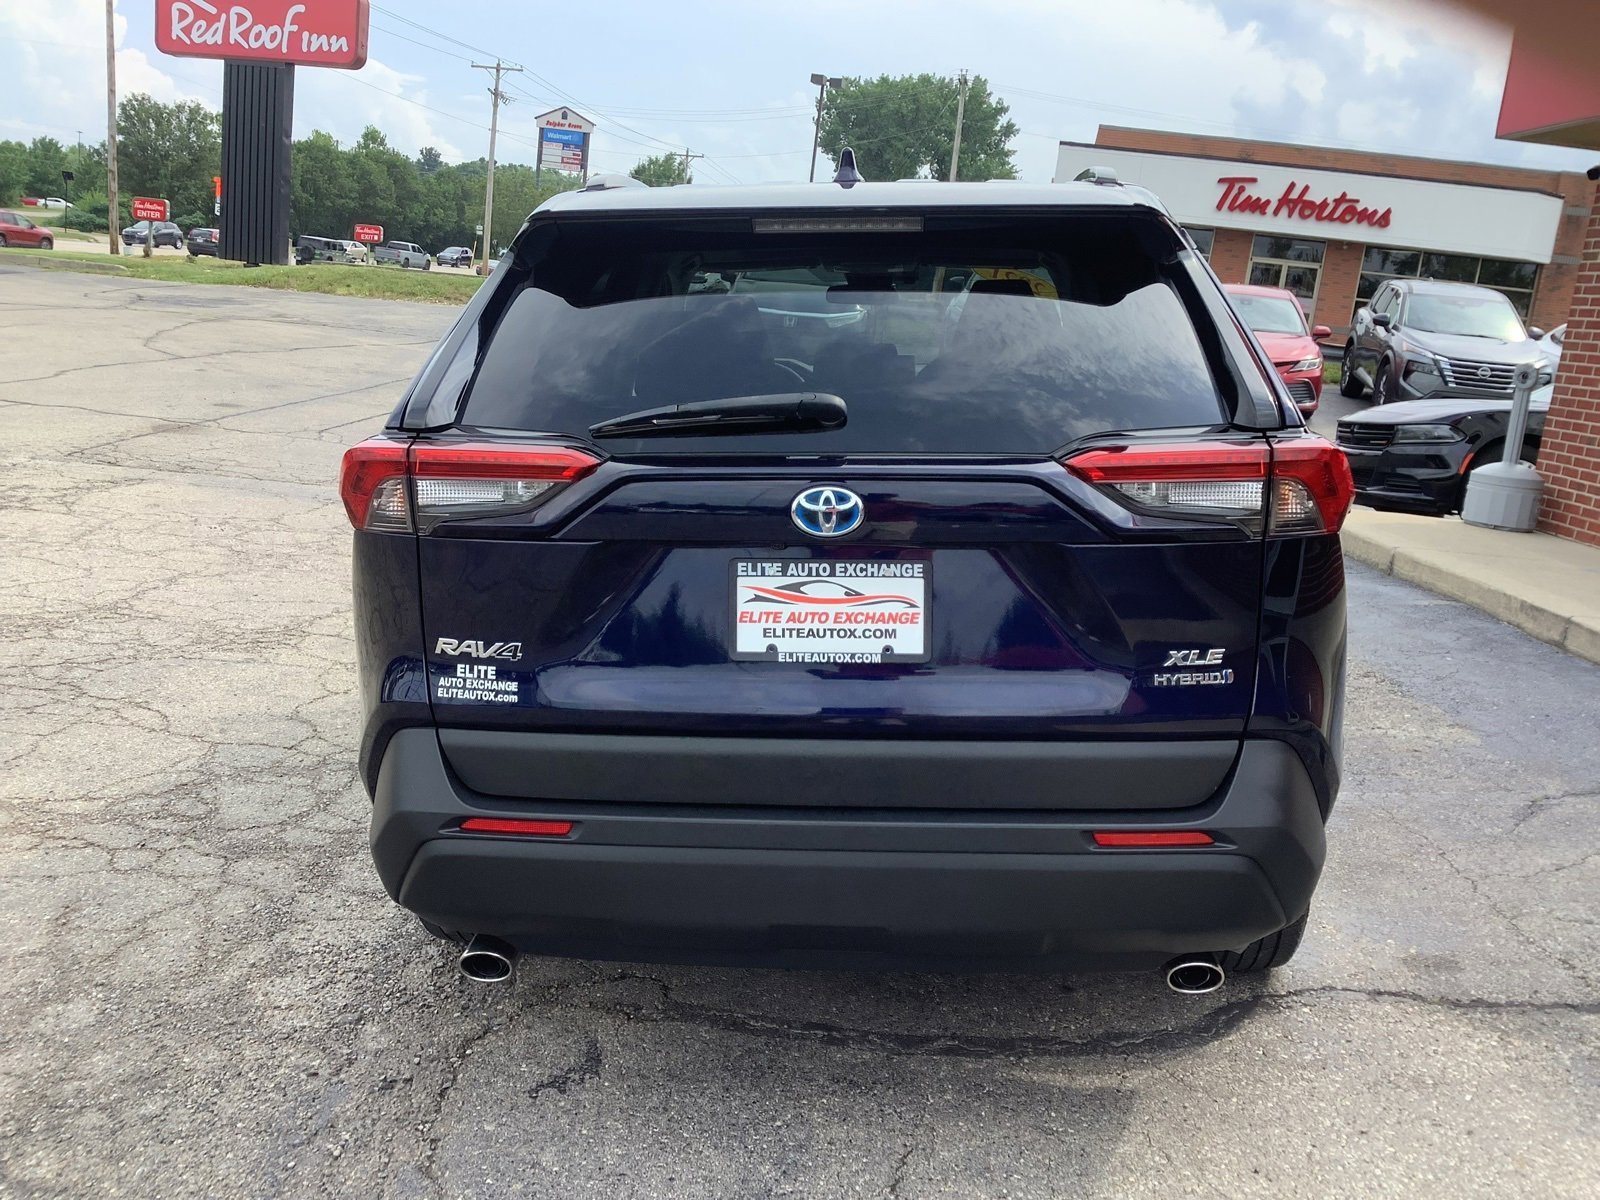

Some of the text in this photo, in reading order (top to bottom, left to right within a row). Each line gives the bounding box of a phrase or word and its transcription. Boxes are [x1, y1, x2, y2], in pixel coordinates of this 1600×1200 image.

[547, 132, 572, 141] Walmart
[1216, 177, 1393, 229] Tim Hortons
[137, 210, 160, 219] ENTER
[361, 233, 374, 241] EXIT
[737, 562, 924, 577] ELITE AUTO EXCHANGE
[738, 611, 921, 625] ELITE AUTO EXCHANGE
[762, 627, 897, 639] ELITEAUTOX.COM
[435, 637, 523, 661] RAV4
[778, 652, 882, 663] ELITEAUTOX.COM
[1163, 648, 1226, 667] XLE
[456, 663, 497, 680] ELITE
[438, 676, 519, 692] AUTO EXCHANGE
[1154, 672, 1222, 686] HYBRID
[437, 687, 519, 703] ELITEAUTOX.com
